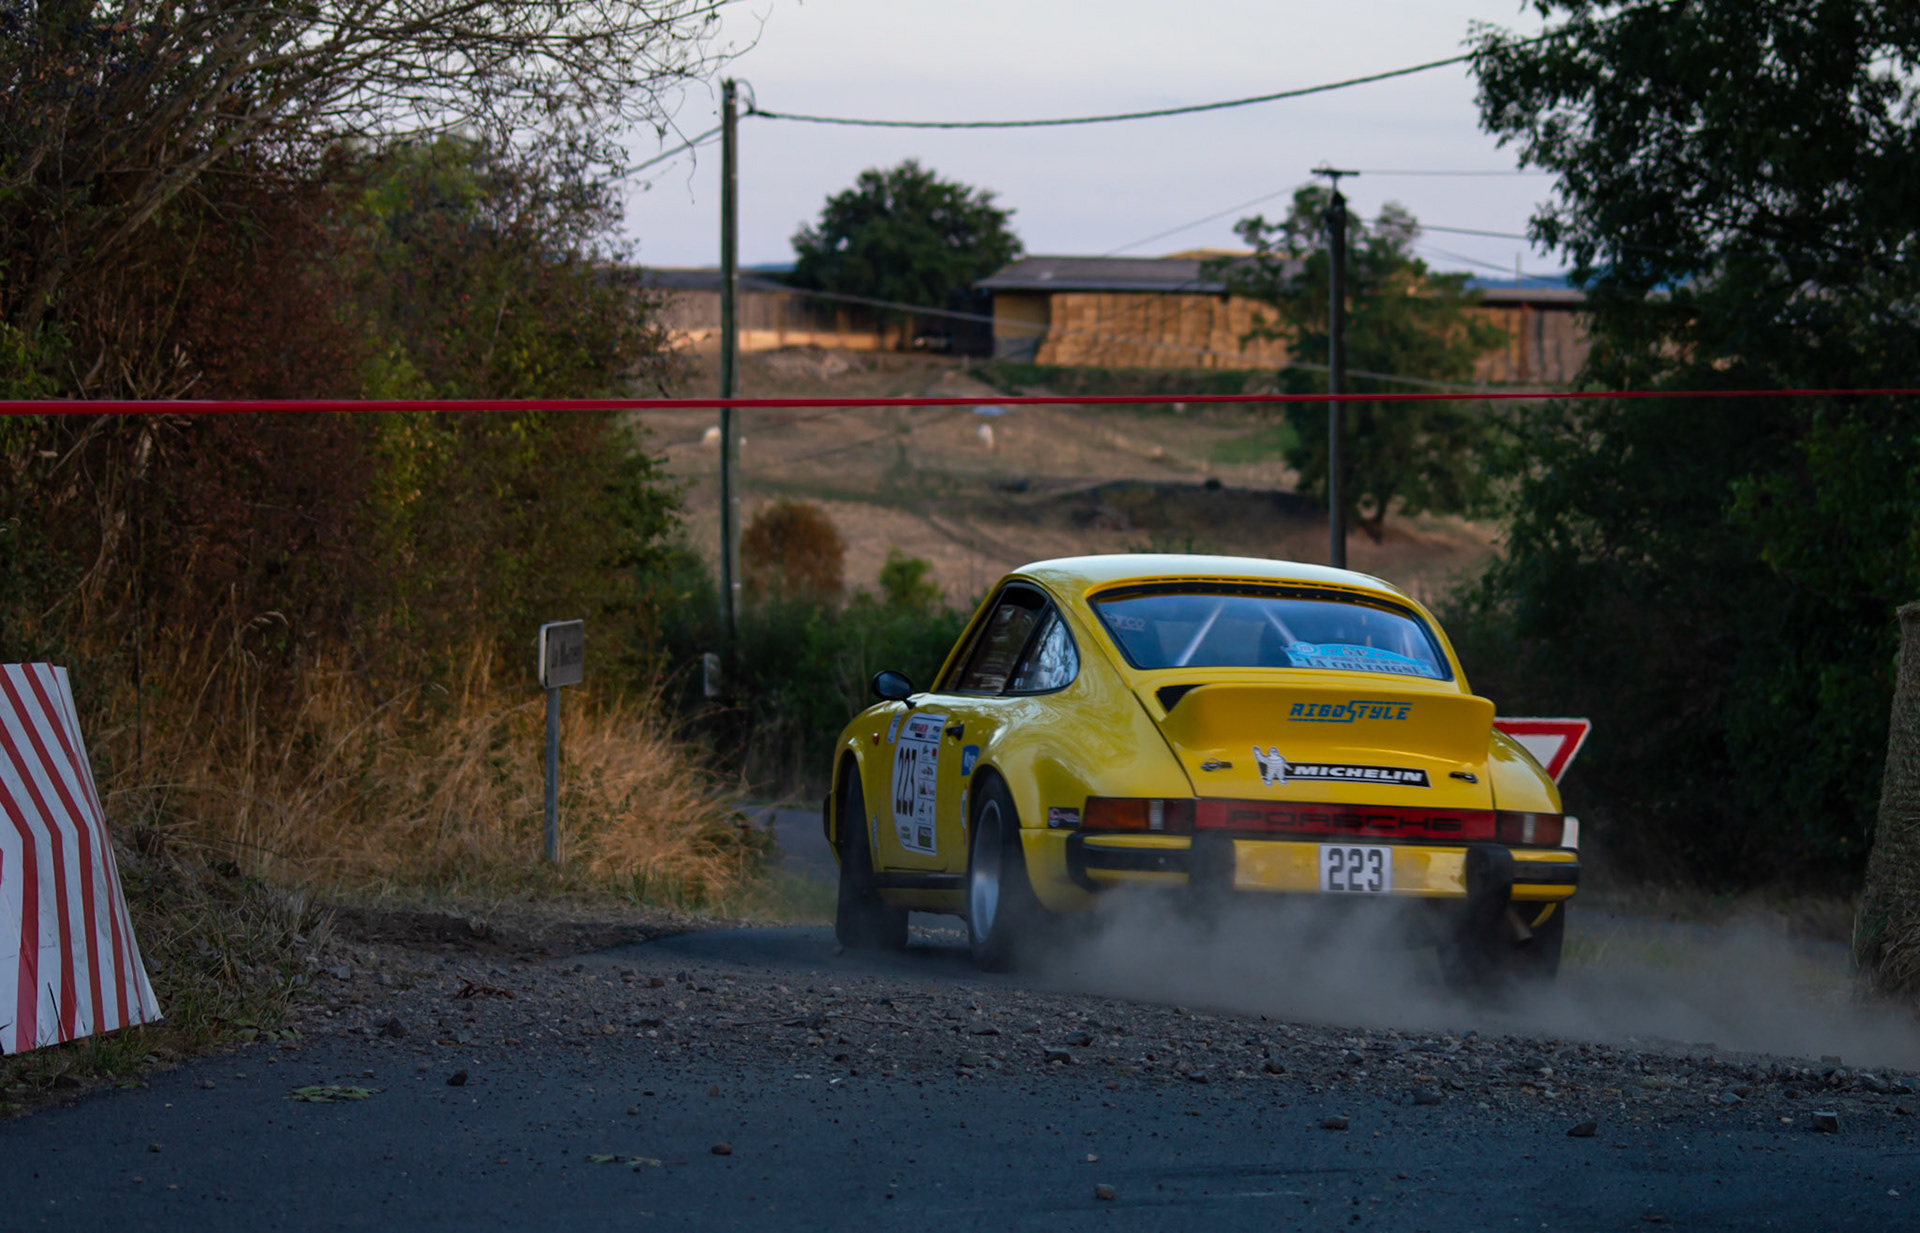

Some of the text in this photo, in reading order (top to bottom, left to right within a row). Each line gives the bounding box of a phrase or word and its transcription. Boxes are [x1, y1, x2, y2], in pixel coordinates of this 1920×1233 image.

[1303, 657, 1326, 668] LA
[895, 747, 917, 818] 223
[1293, 765, 1423, 782] MICHELIN
[1230, 809, 1462, 832] PORSCHE
[1327, 847, 1383, 892] 223
